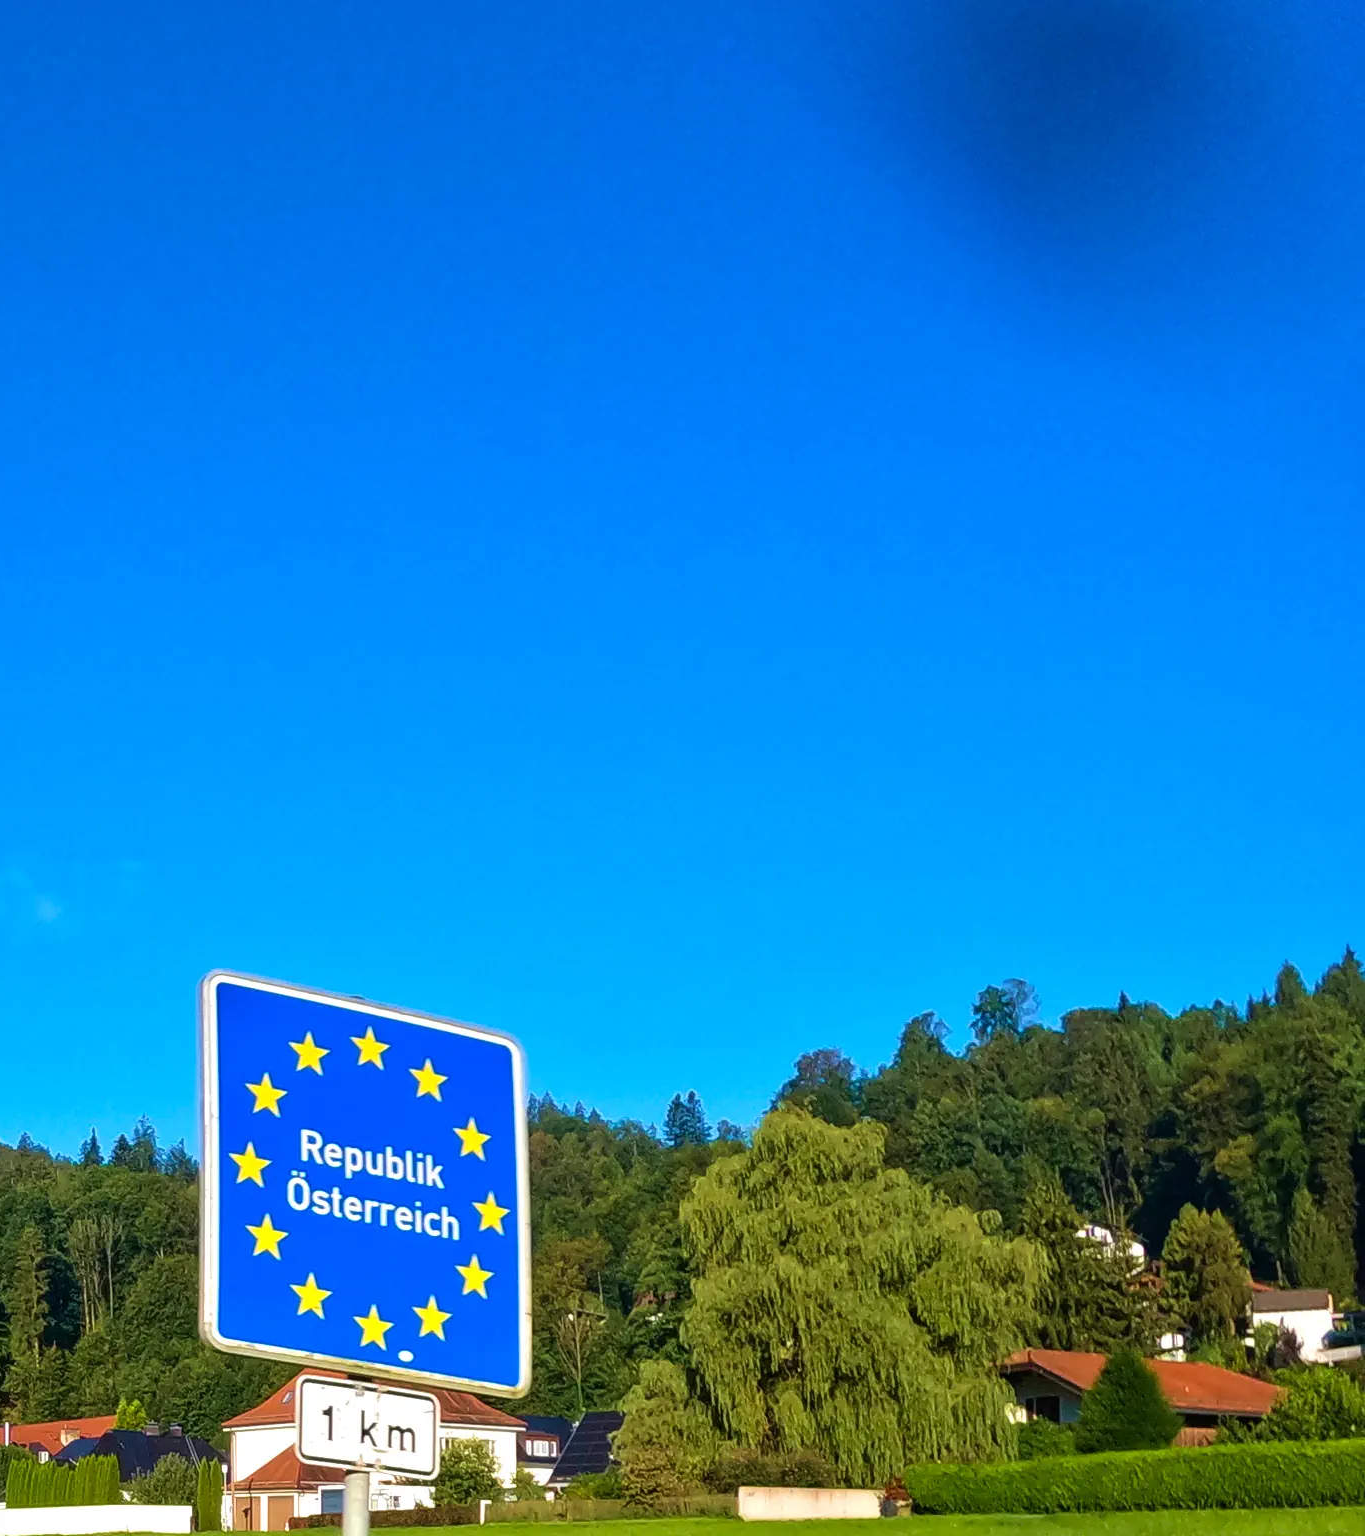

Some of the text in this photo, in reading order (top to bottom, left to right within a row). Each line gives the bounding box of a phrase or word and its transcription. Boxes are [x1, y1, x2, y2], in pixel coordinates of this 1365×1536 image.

[300, 1128, 445, 1189] Republik
[287, 1170, 460, 1240] Österreich
[321, 1405, 416, 1453] 1 km
